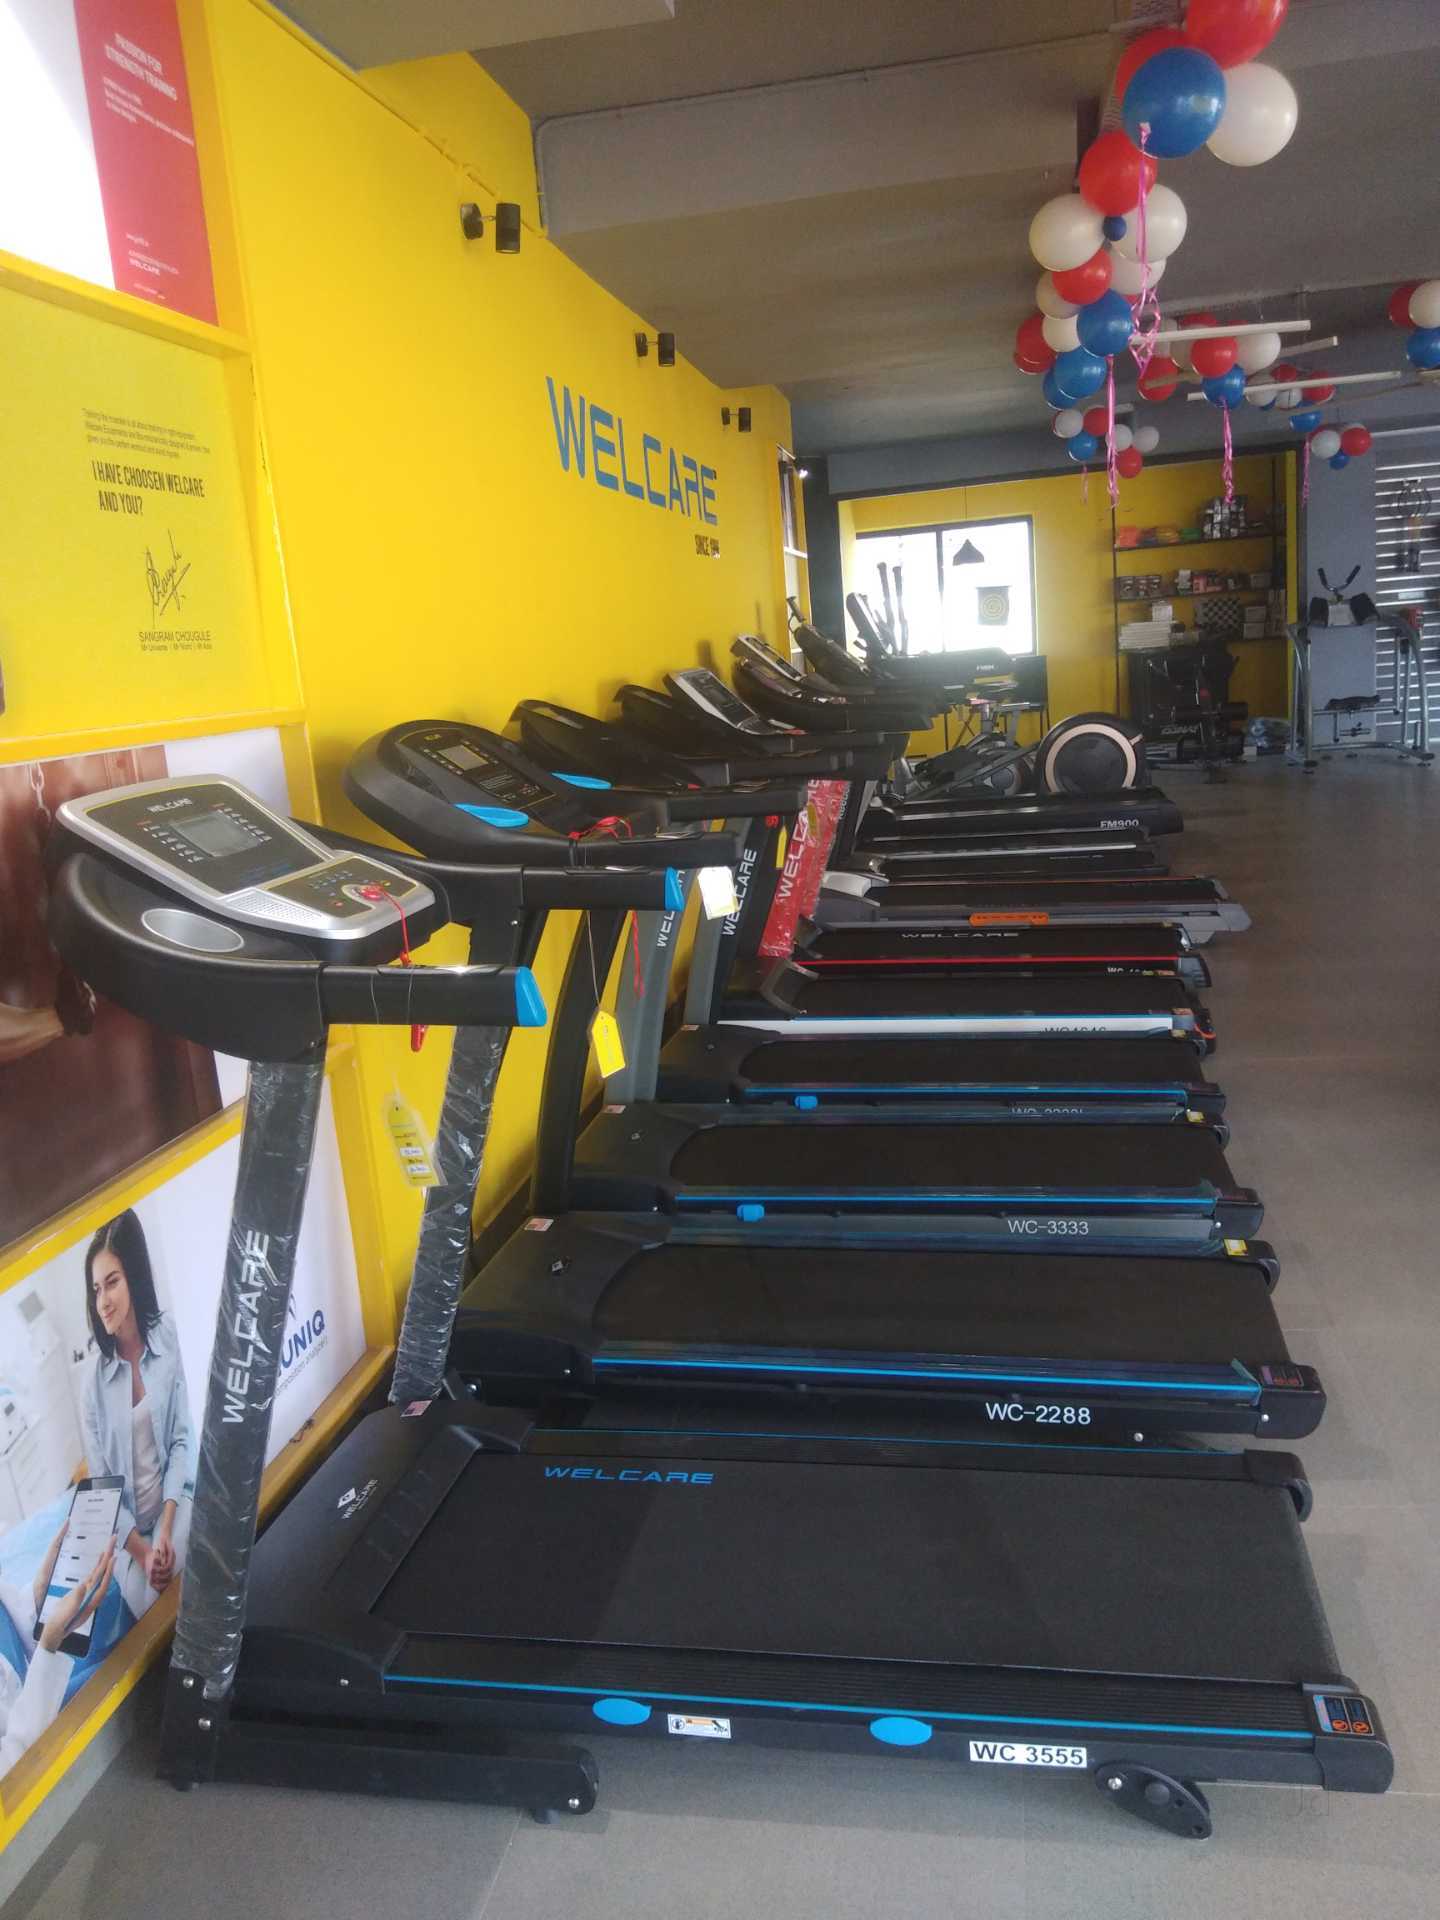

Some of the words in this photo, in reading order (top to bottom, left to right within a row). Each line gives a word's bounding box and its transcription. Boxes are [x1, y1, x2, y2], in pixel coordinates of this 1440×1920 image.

[546, 376, 718, 526] WELCARE
[97, 461, 123, 486] HAVE
[123, 465, 165, 492] CHOOSEN
[166, 473, 205, 498] WELCARE
[98, 490, 119, 514] AND
[120, 492, 144, 516] YOU?
[1007, 1218, 1089, 1237] WC-3333
[222, 1229, 269, 1423] WELCARE
[985, 1401, 1092, 1427] WC-2288
[544, 1465, 714, 1486] WELCARE
[973, 1743, 1018, 1763] WC
[1026, 1745, 1084, 1766] 3555
